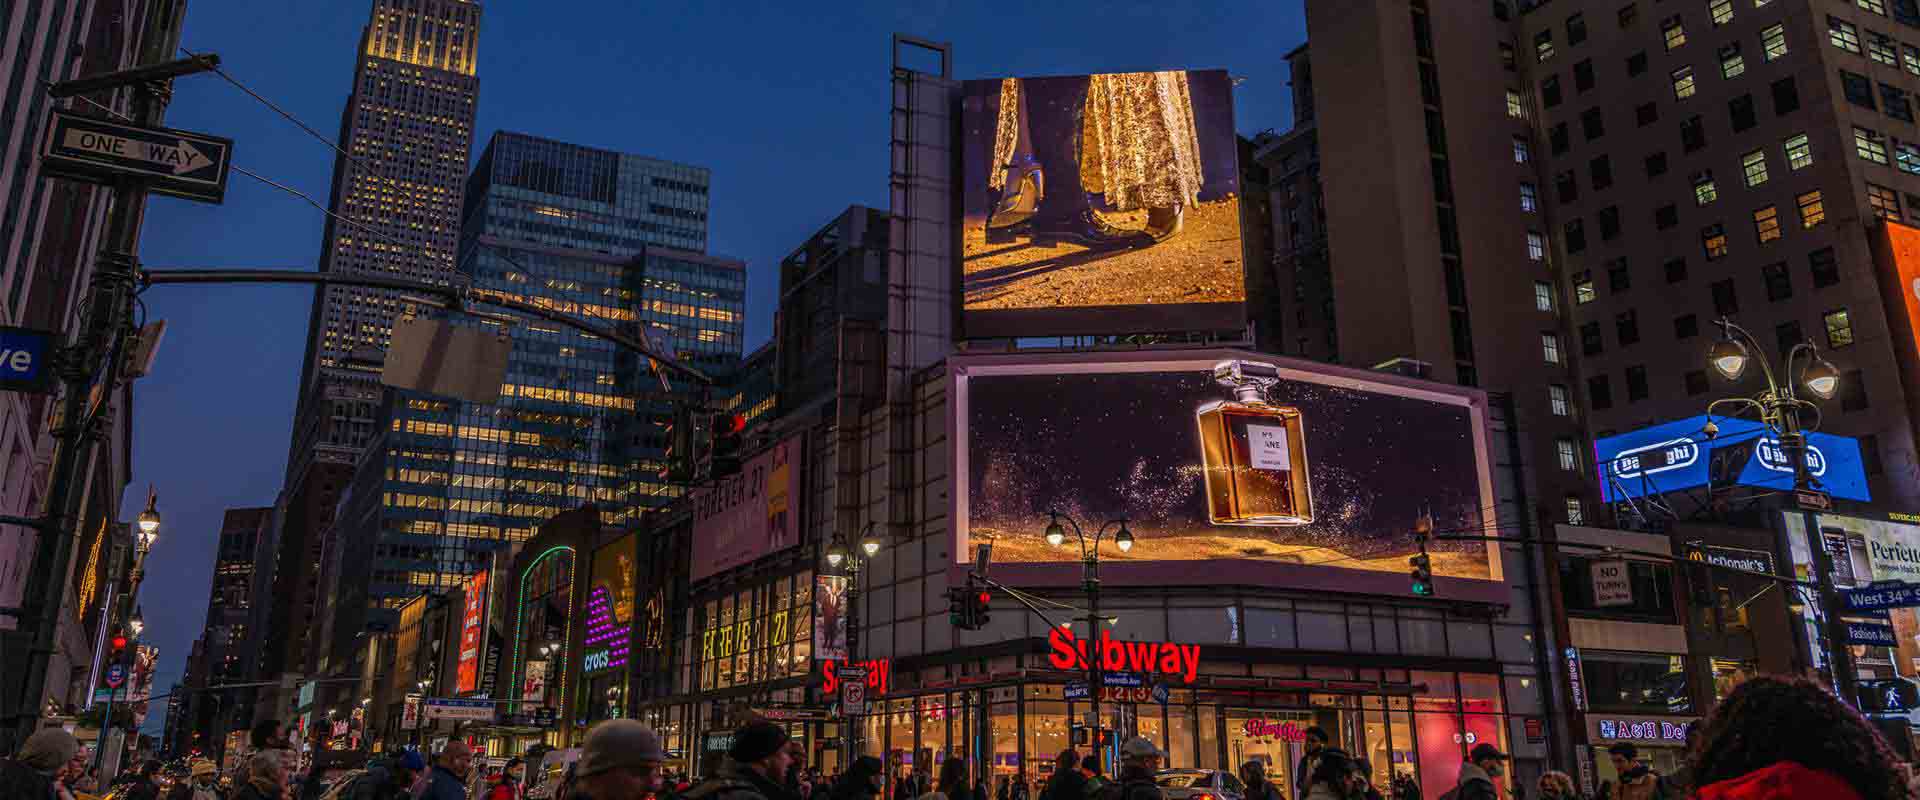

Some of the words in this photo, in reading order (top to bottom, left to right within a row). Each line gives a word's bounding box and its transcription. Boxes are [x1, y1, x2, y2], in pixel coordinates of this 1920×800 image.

[80, 133, 127, 154] ONE
[149, 143, 198, 166] WAY
[697, 474, 746, 521] FOREVER
[1600, 567, 1619, 578] NO
[1848, 590, 1884, 606] West
[773, 610, 789, 647] 21
[1848, 627, 1879, 641] Fashion
[1879, 630, 1894, 641] Ave
[584, 649, 609, 672] crocs
[1115, 687, 1125, 700] 2
[1137, 687, 1147, 700] 3
[1617, 720, 1657, 739] A&H
[1664, 720, 1688, 739] Del
